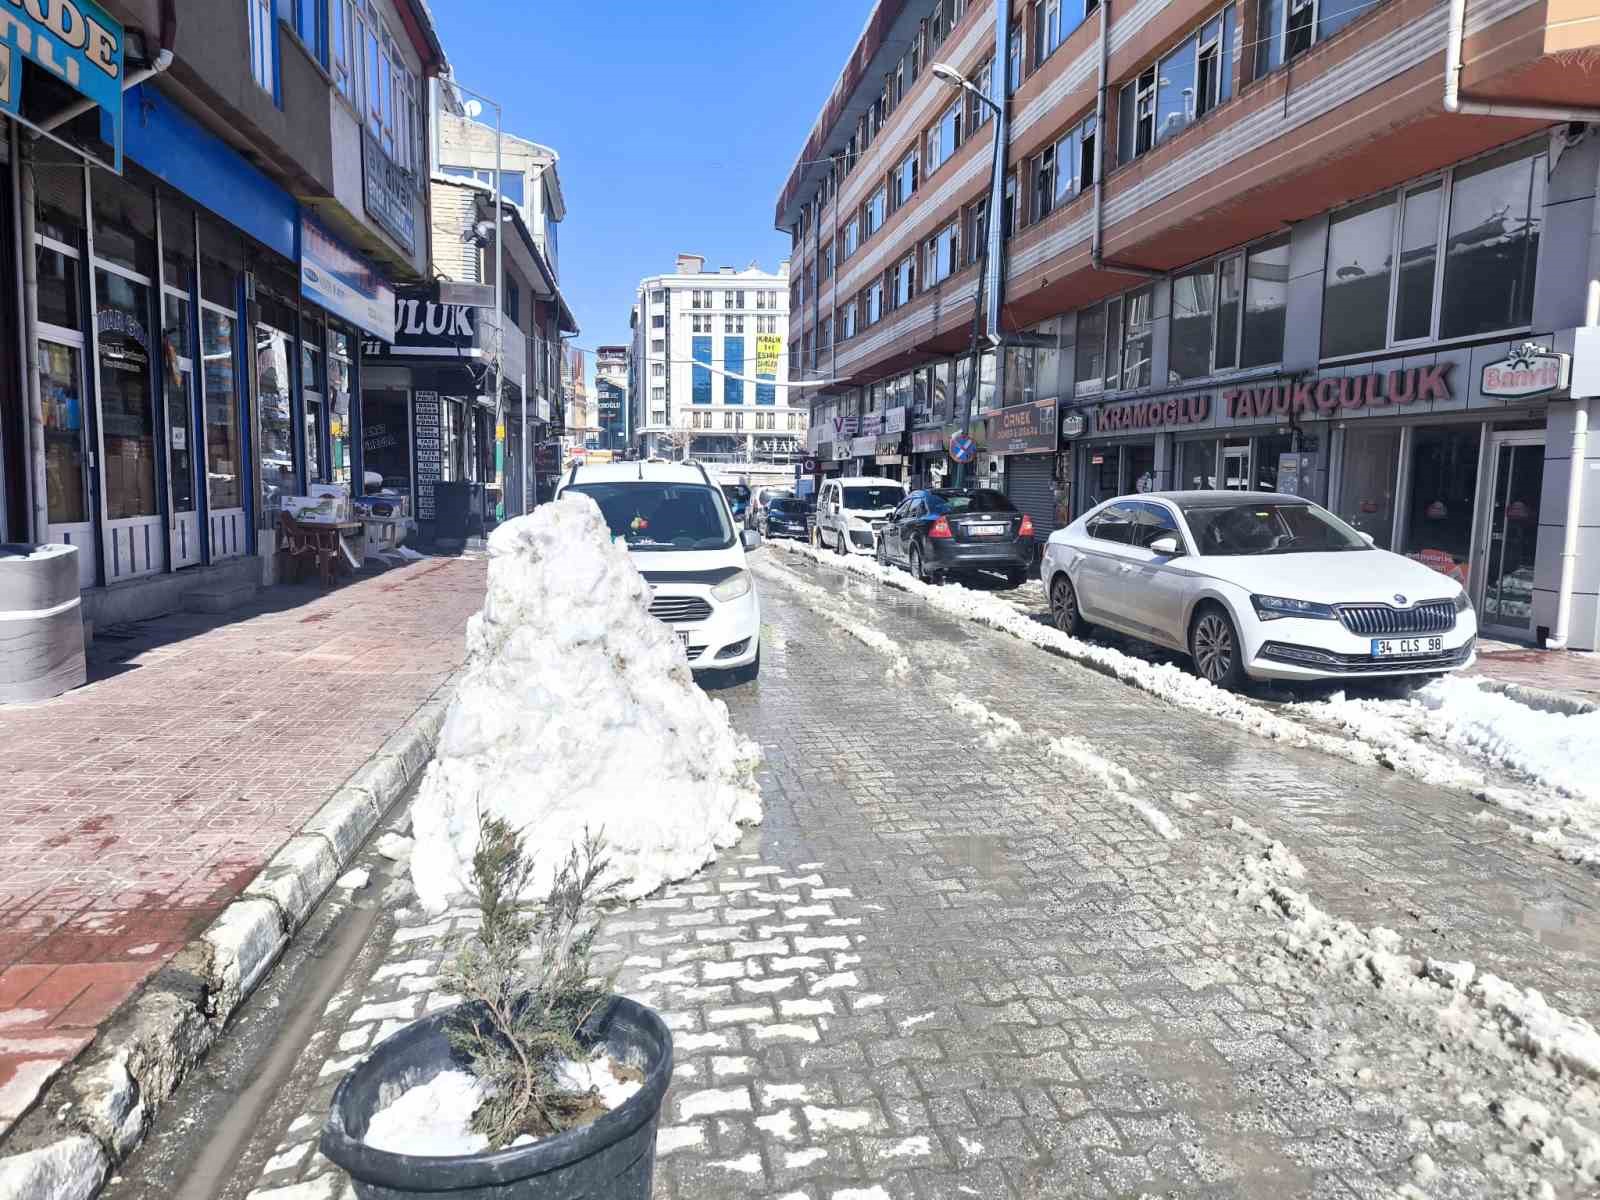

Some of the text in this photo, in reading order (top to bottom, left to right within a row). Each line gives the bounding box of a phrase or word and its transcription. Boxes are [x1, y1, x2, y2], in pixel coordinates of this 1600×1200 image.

[1222, 365, 1453, 418] TAVUKÇULUK
[1379, 639, 1441, 654] 34 CLS 98
